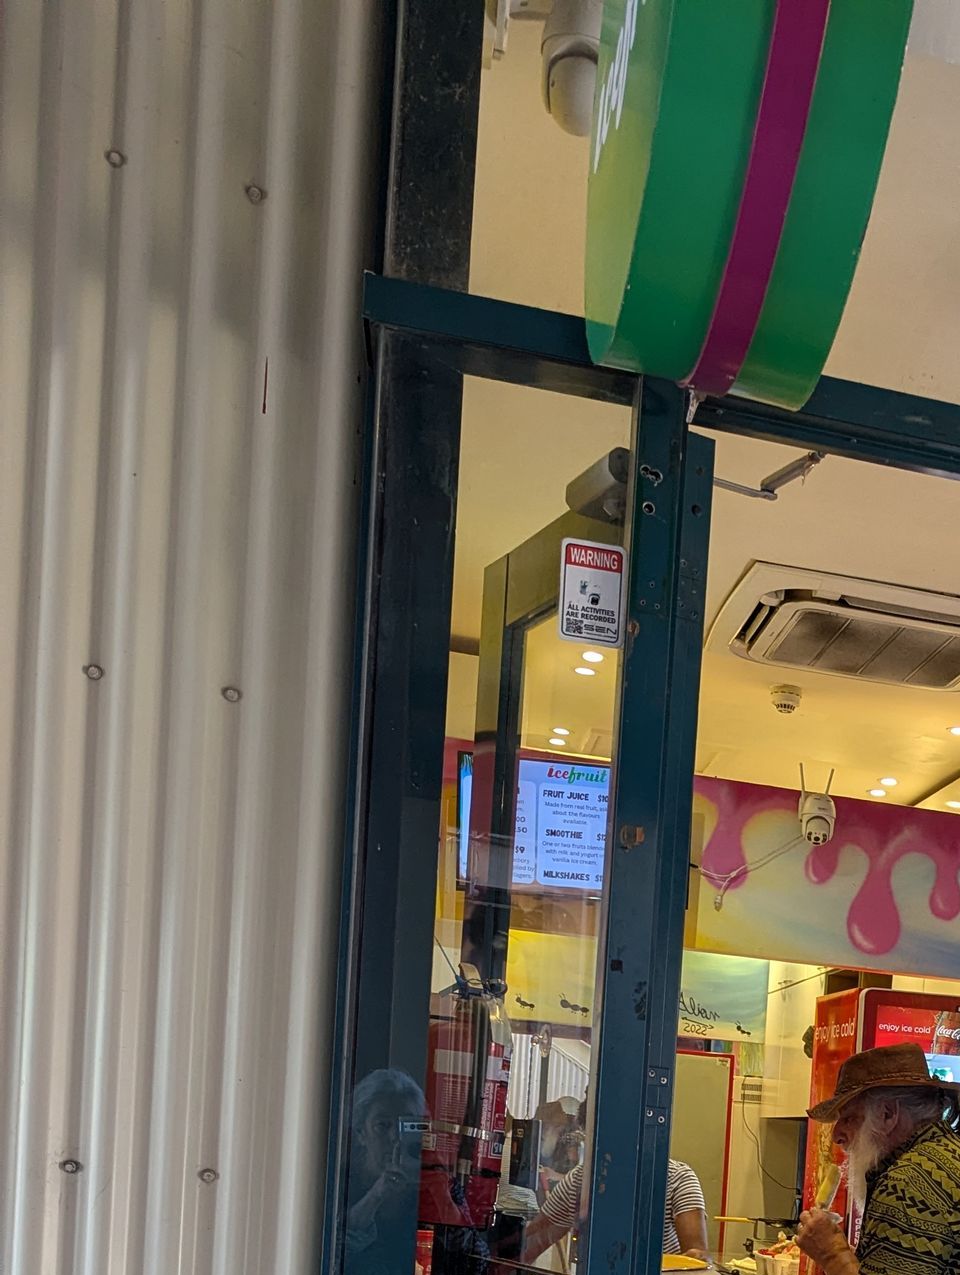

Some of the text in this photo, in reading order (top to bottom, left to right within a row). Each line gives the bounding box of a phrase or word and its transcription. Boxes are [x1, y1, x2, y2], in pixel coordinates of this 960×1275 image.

[570, 546, 618, 570] WARNING
[565, 610, 617, 624] ARE RECORDED
[567, 603, 616, 617] ALL ACTIVITIES
[547, 765, 608, 784] icefruit
[542, 789, 565, 799] FRUIT
[567, 791, 590, 801] JUICE
[545, 828, 584, 839] SMOOTHIE
[543, 869, 590, 881] MILKSHAKES
[683, 1022, 707, 1036] 2022
[878, 1022, 931, 1034] enjoy ice cold
